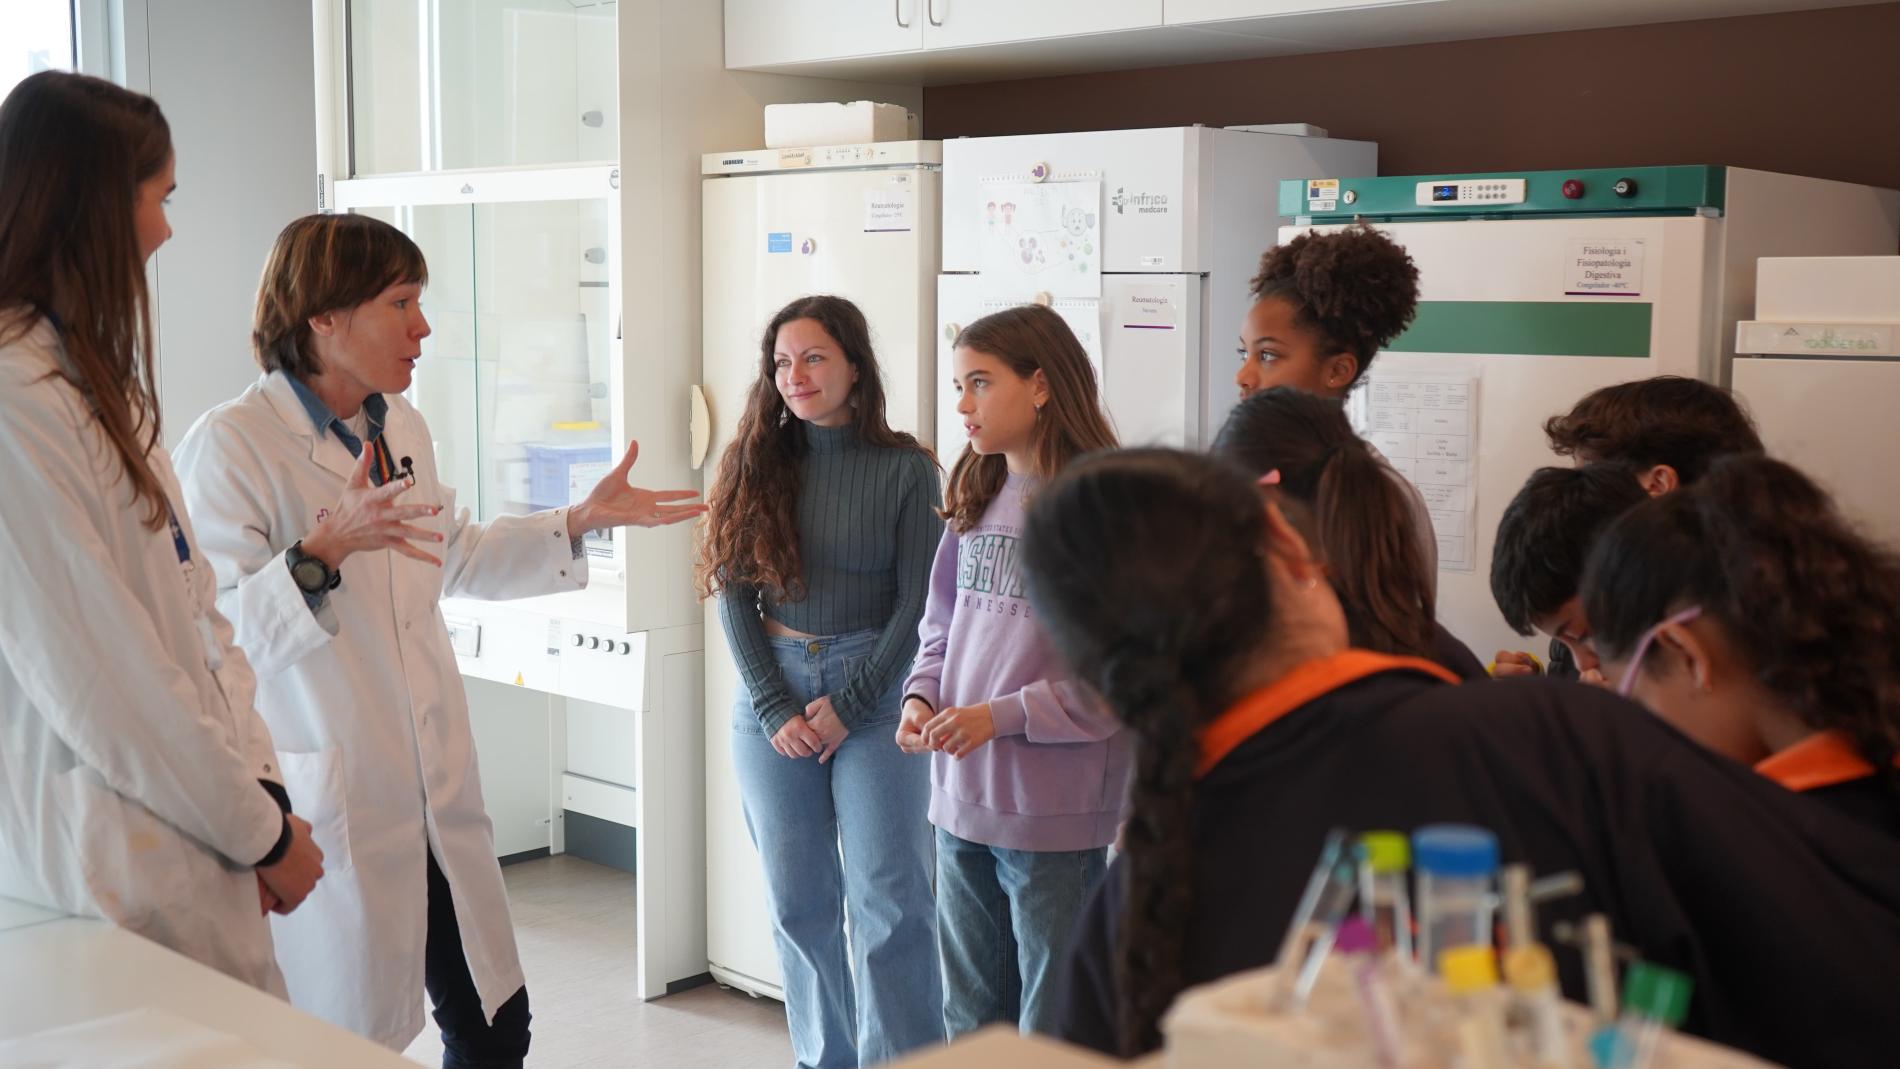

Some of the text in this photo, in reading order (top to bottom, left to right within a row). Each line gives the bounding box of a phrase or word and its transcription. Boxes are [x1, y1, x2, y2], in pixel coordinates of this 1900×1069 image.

[1130, 192, 1168, 206] infrico
[1138, 206, 1168, 214] medcare
[1583, 246, 1621, 256] Fisiologia
[1576, 258, 1632, 269] Fisiopatologia
[1584, 270, 1622, 281] Digestiva
